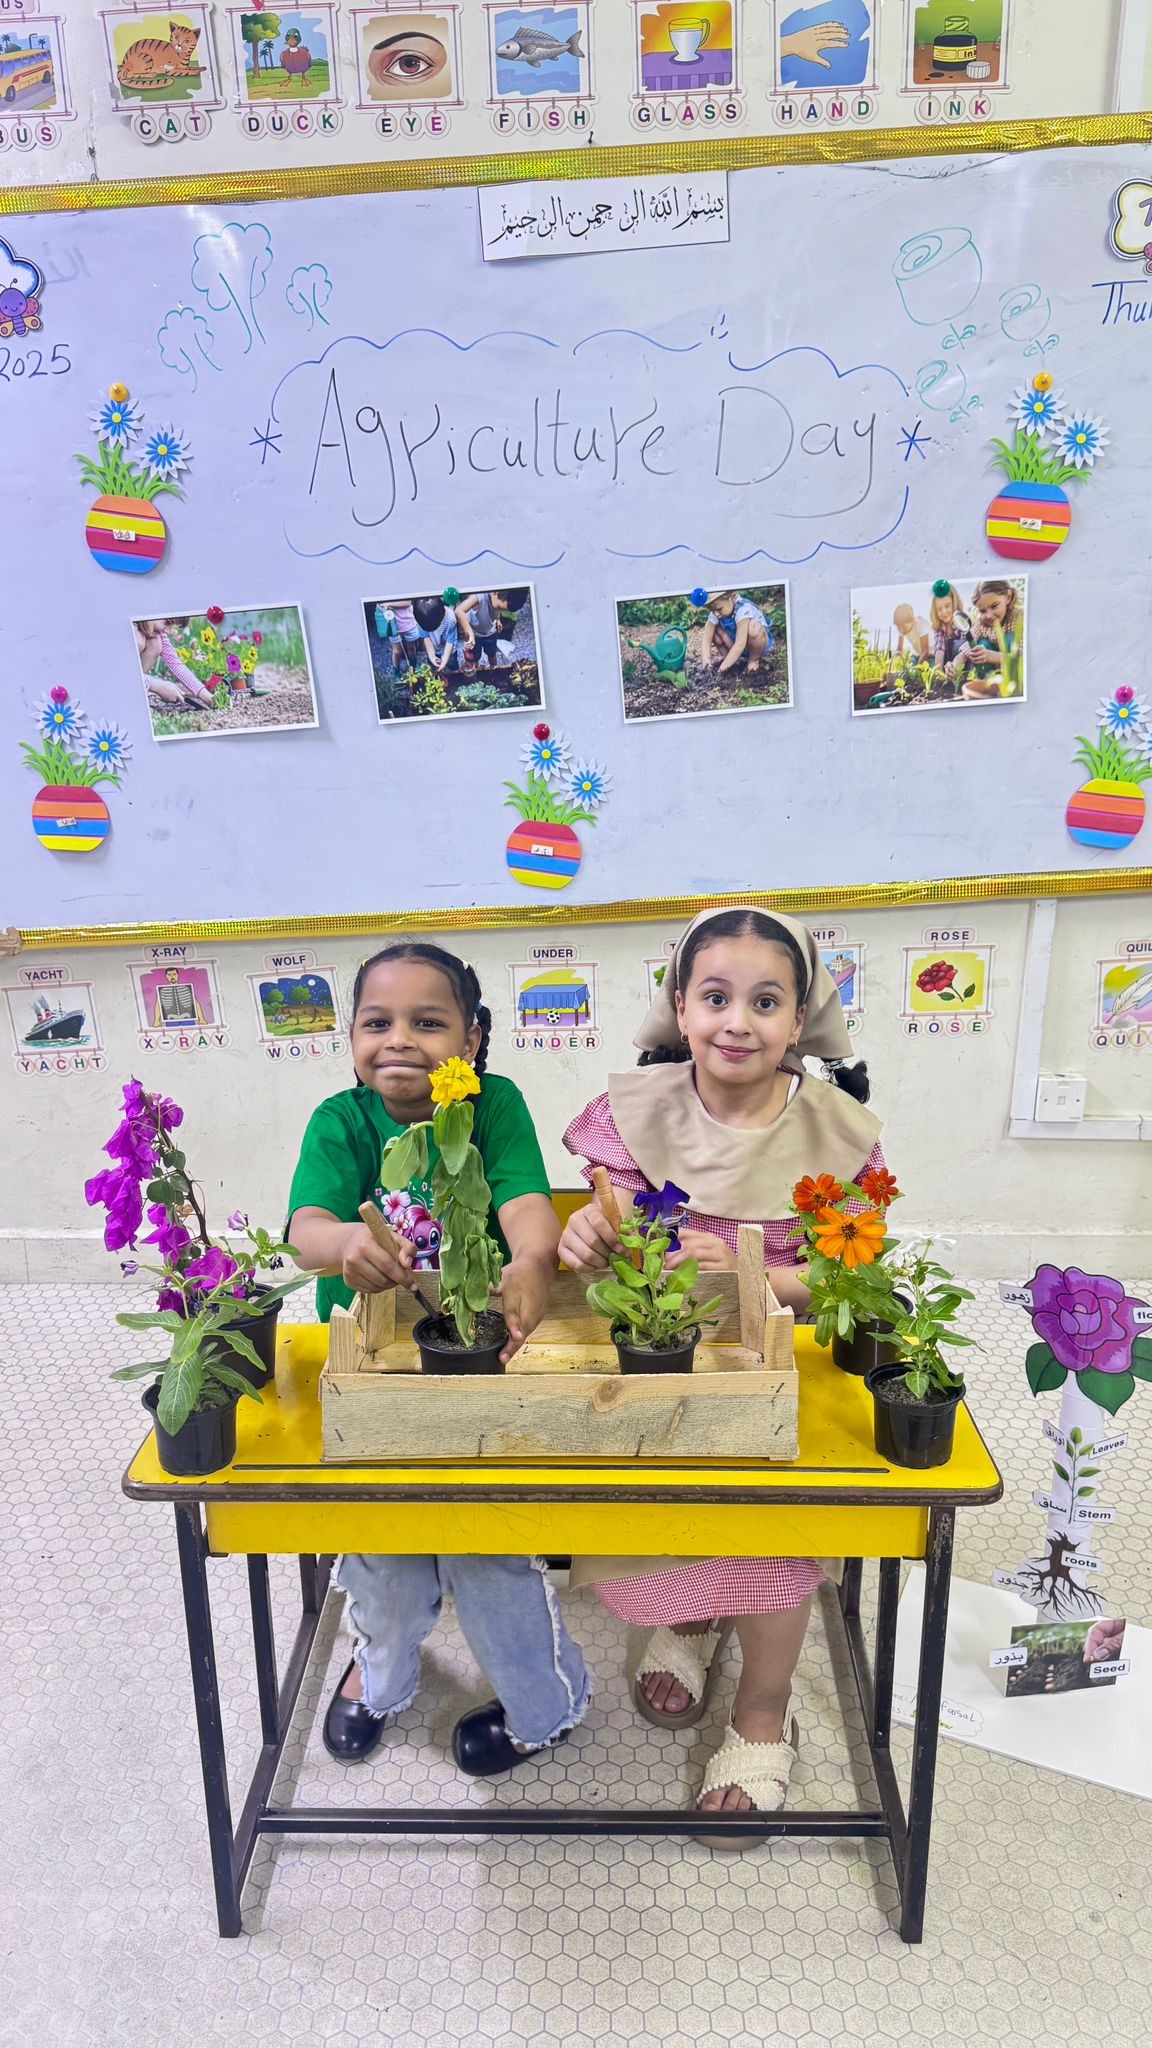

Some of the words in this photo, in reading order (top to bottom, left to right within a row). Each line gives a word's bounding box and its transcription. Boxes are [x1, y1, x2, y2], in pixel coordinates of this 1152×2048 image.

[638, 103, 738, 123] GLASS
[781, 100, 870, 121] HAND
[928, 100, 986, 116] INK
[139, 115, 200, 135] CAT
[248, 112, 335, 132] DUCK
[381, 115, 442, 134] EYE
[499, 110, 586, 129] FISH
[1092, 280, 1152, 325] Thu
[0, 343, 71, 382] 2025
[308, 367, 679, 527] Agriculture
[714, 385, 877, 518] Day
[813, 930, 836, 940] HIP
[930, 931, 970, 941] ROSE
[151, 947, 187, 958] X-RAY
[533, 948, 573, 959] UNDER
[272, 955, 306, 967] WOLF
[24, 969, 64, 981] YACHT
[908, 1021, 982, 1034] ROSE
[143, 1034, 225, 1049] X-RAY
[516, 1036, 596, 1050] UNDER
[1096, 1035, 1142, 1047] QUI
[268, 1041, 341, 1058] WOLF
[20, 1056, 102, 1072] YACHT
[1004, 1292, 1031, 1304] زهور
[1092, 1439, 1125, 1454] Leaves
[1039, 1497, 1067, 1513] ساق
[1078, 1510, 1111, 1519] Stem
[1065, 1556, 1097, 1568] roots
[998, 1576, 1029, 1589] جذور
[995, 1652, 1024, 1665] بذور
[1093, 1664, 1126, 1674] Seed
